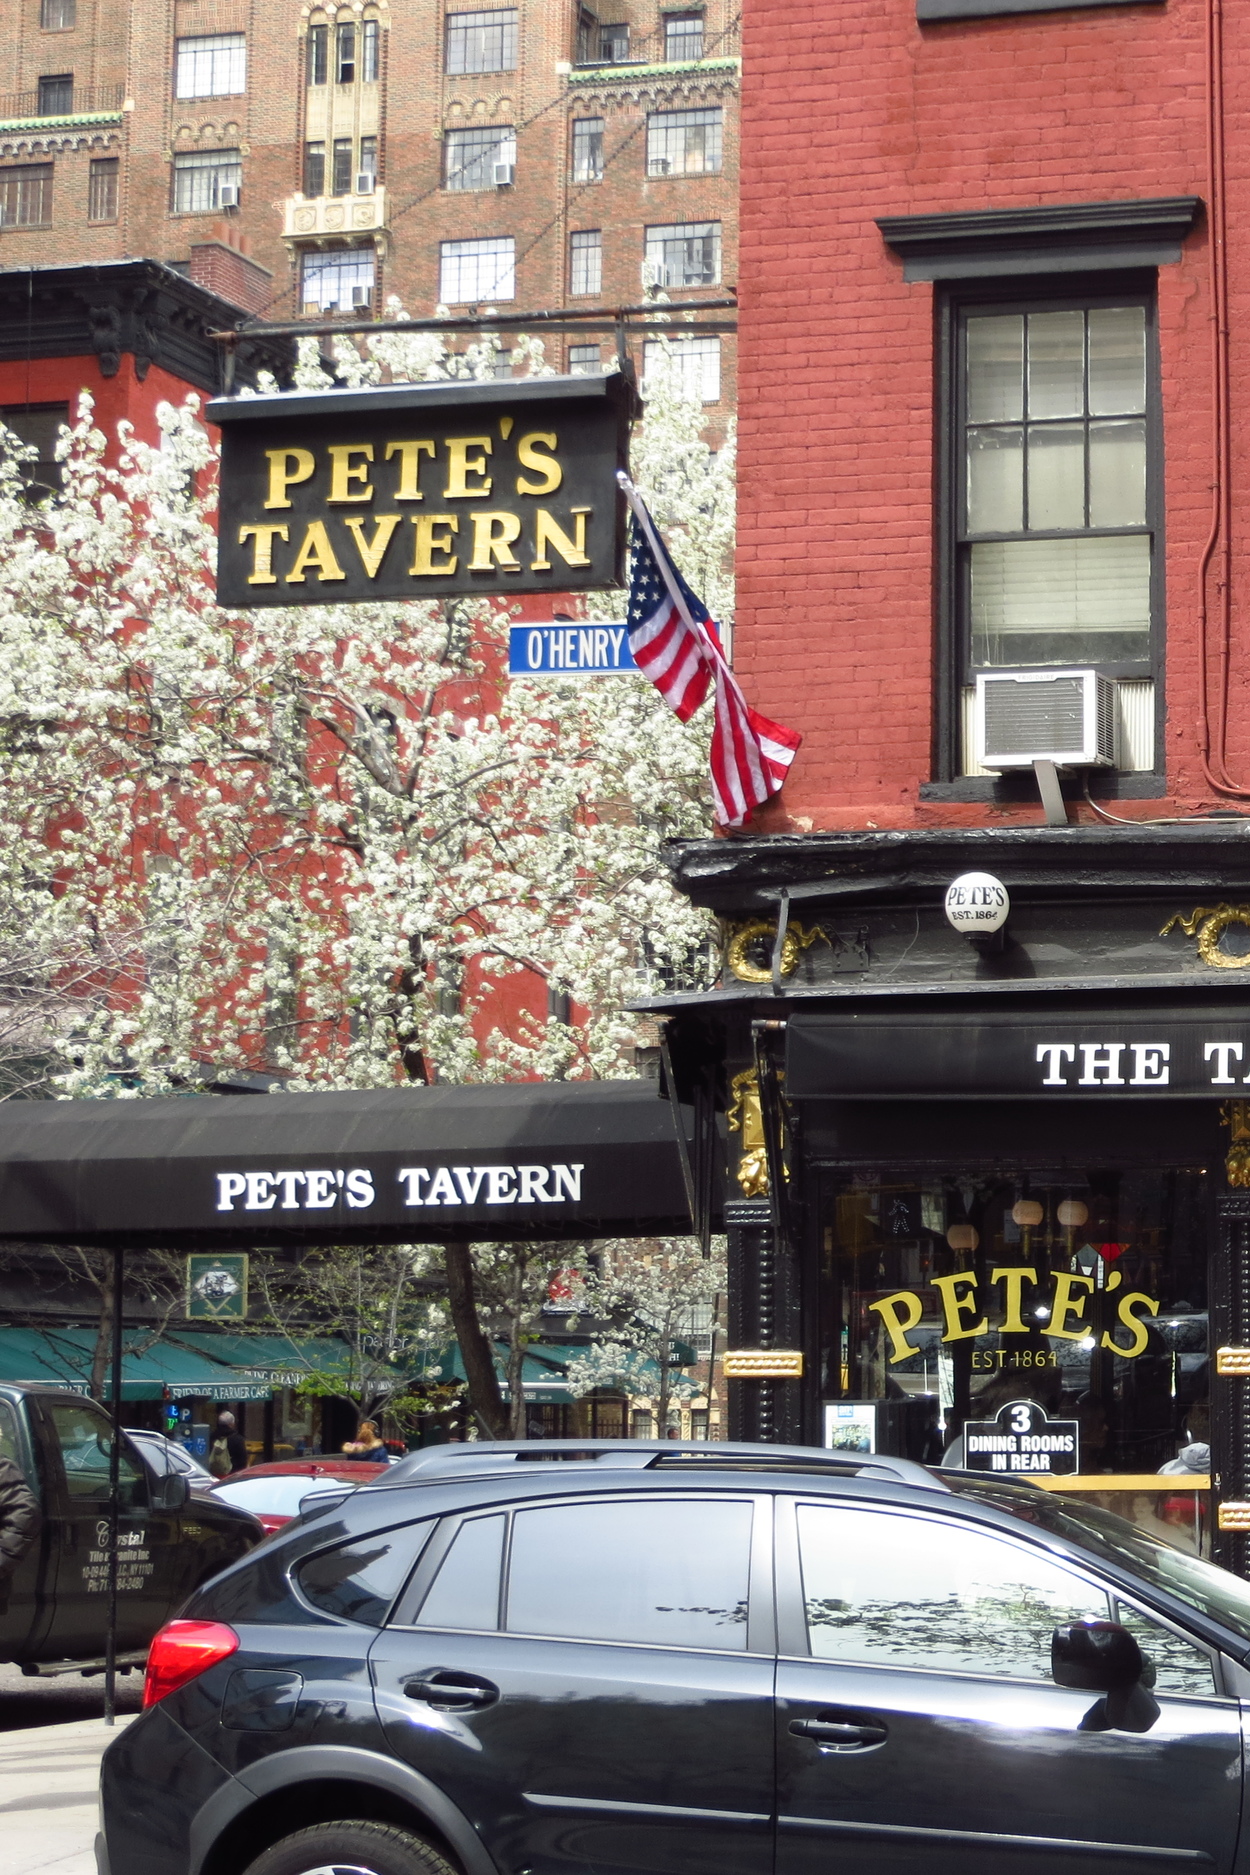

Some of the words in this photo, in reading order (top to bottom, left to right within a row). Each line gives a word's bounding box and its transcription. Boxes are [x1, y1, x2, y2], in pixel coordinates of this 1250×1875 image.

[264, 417, 563, 510] PETE'S
[238, 507, 593, 585] TAVERN
[527, 628, 625, 670] O'HENRY
[947, 886, 1005, 907] PETE'S
[1035, 1042, 1171, 1087] THE
[215, 1169, 376, 1211] PETE'S
[399, 1163, 585, 1206] TAVERN
[868, 1267, 1160, 1365] PETE'S
[1014, 1350, 1058, 1368] 1864
[213, 1389, 220, 1399] A
[220, 1386, 251, 1399] FARMER
[1011, 1405, 1031, 1433] 3
[968, 1435, 1017, 1452] DINING
[1021, 1435, 1074, 1452] ROOMS
[992, 1454, 1007, 1470] IN
[1010, 1454, 1051, 1470] REAR
[90, 1551, 104, 1562] Tile
[138, 1550, 150, 1560] Inc
